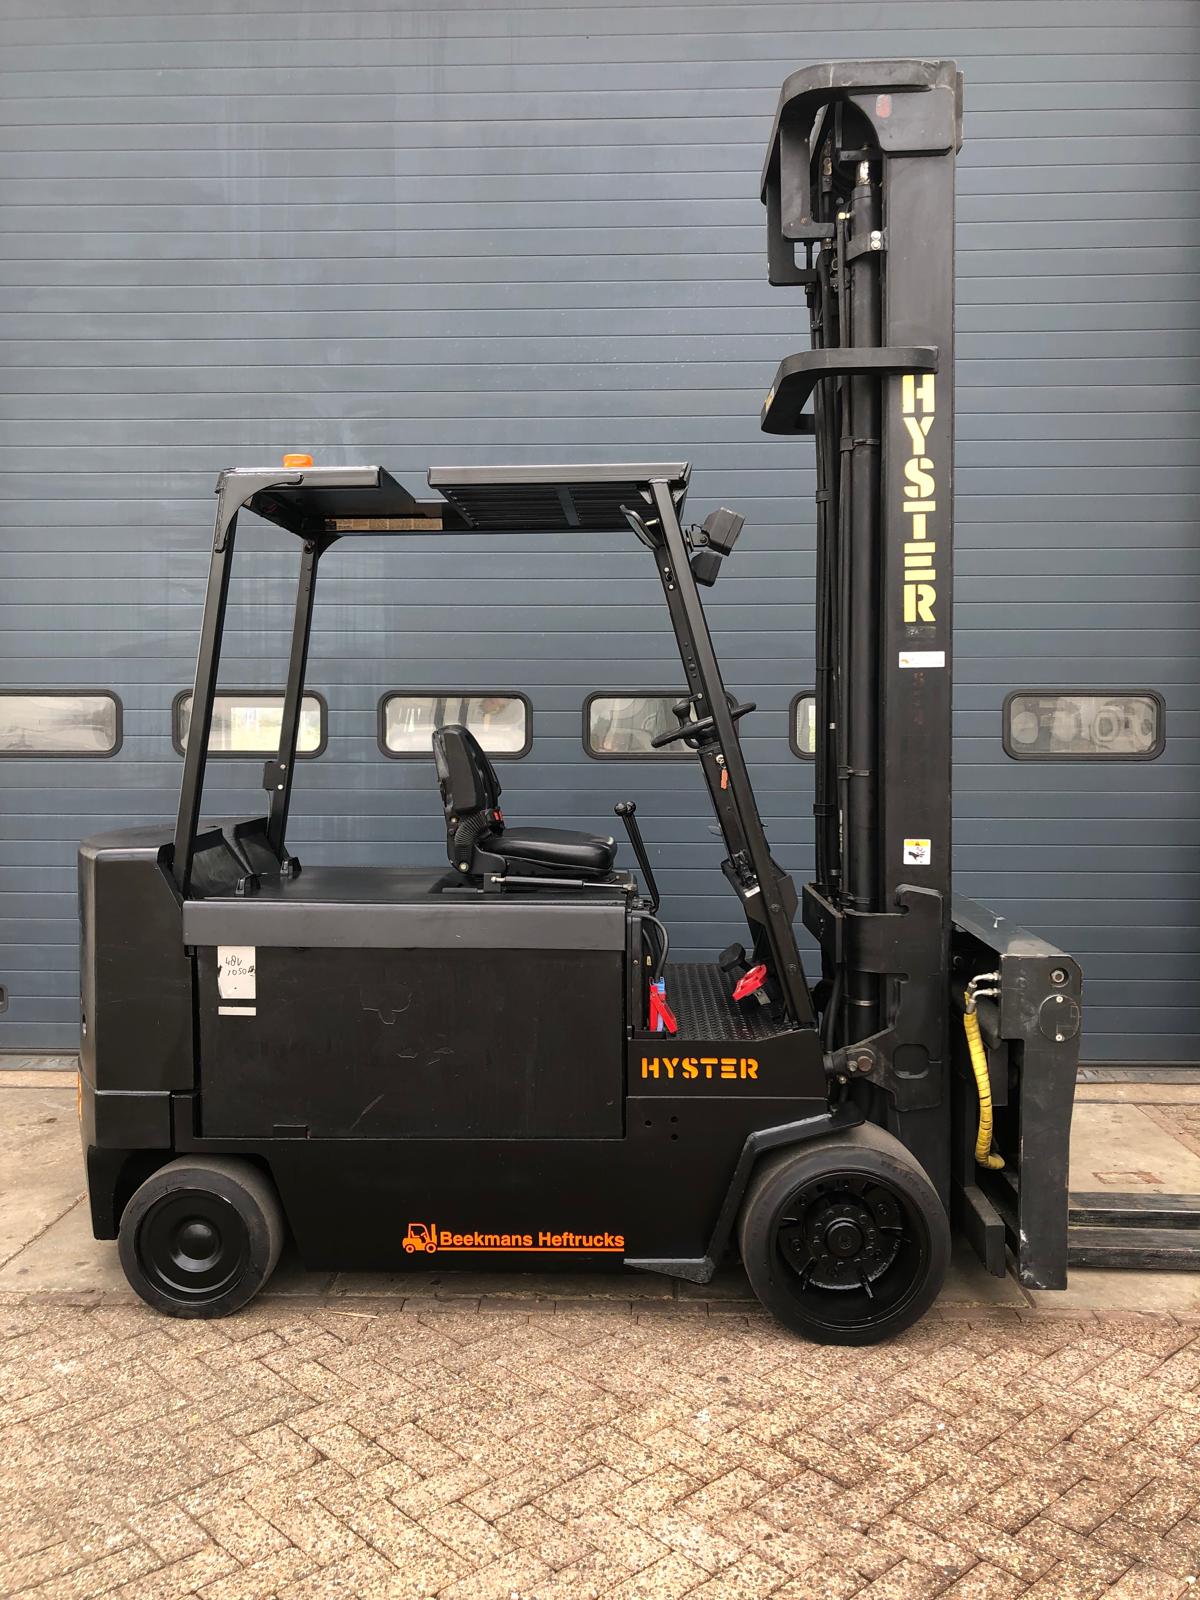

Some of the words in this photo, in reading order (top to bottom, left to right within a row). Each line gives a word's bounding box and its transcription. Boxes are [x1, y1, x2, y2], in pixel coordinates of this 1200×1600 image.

[902, 374, 937, 623] HYSTER
[641, 1057, 759, 1079] HYSTER
[440, 1231, 533, 1247] Beekmans
[538, 1231, 625, 1248] Heftrucks
